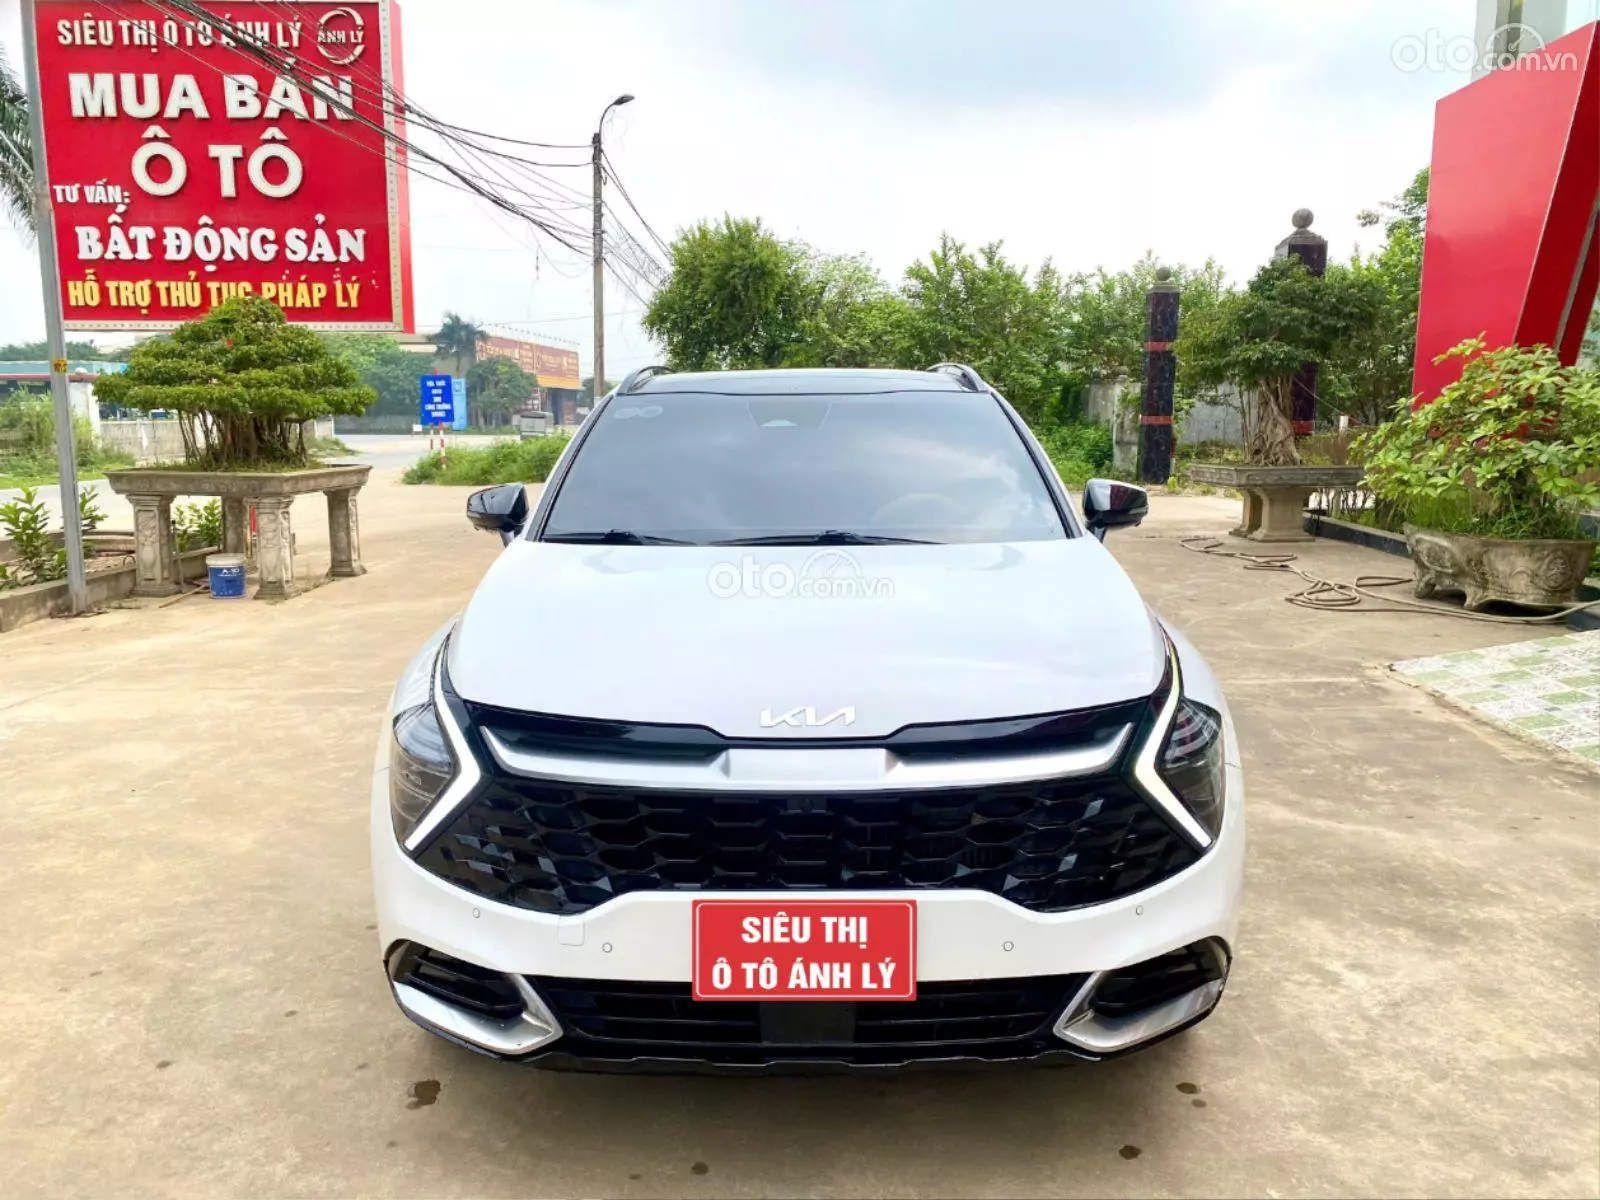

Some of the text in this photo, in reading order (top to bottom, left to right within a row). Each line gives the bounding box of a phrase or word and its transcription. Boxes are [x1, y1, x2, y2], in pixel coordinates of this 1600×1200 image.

[57, 12, 114, 46] SIÊU
[118, 19, 158, 53] THỊ
[276, 14, 302, 48] LÝ
[350, 26, 364, 43] LÝ
[68, 57, 355, 120] MUA BÁN
[130, 125, 304, 198] Ô TÔ
[53, 183, 81, 203] TƯ
[74, 204, 366, 272] BẤT ĐỘNG SẢN
[67, 268, 100, 307] HỖ
[105, 279, 152, 315] TRỢ
[155, 270, 201, 307] THỦ
[261, 275, 327, 308] PHÁP
[336, 275, 360, 308] LÝ
[760, 706, 856, 728] KIA
[741, 911, 868, 949] SIÊU THỊ
[712, 957, 896, 990] Ô TÔ ÁNH LÝ
